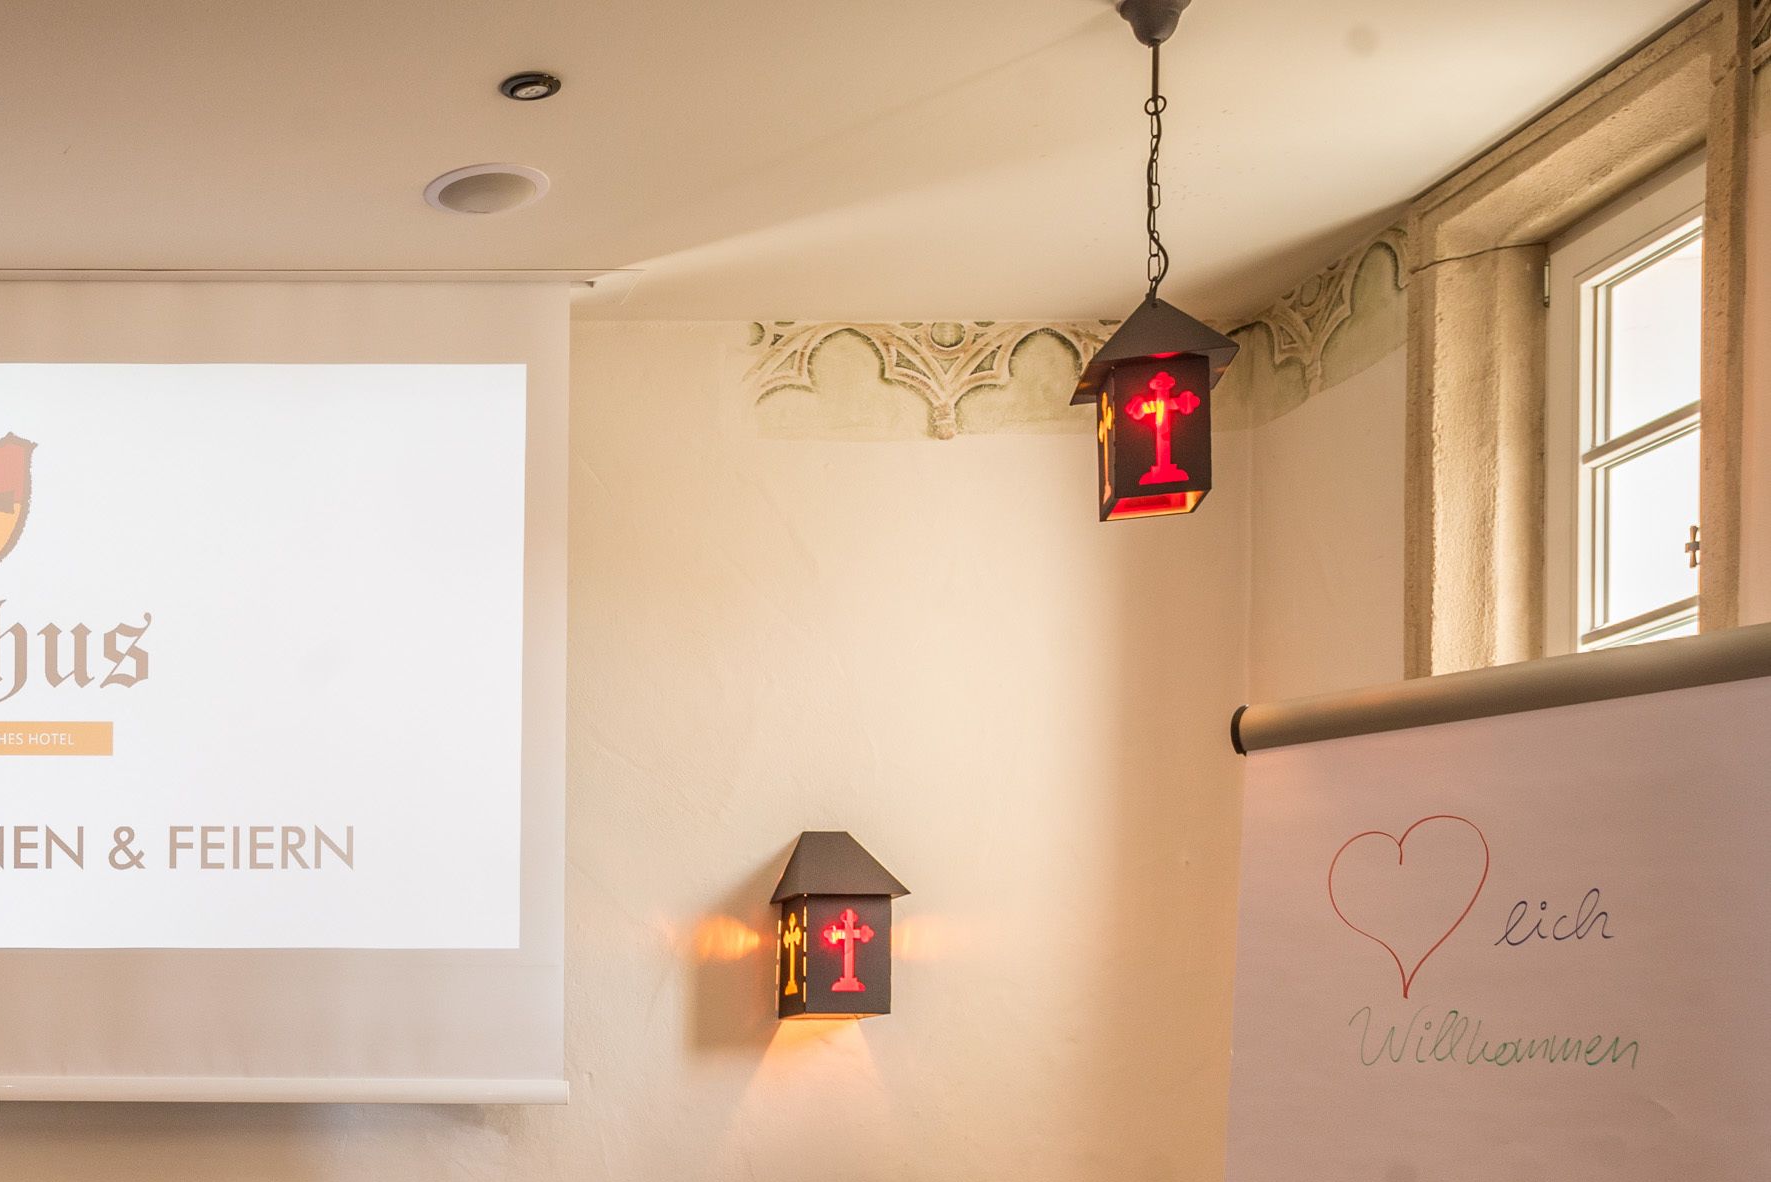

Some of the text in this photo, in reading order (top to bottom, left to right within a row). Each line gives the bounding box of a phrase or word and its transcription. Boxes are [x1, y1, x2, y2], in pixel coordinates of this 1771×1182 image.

[29, 732, 75, 746] HOTEL
[108, 826, 147, 872] &
[169, 826, 354, 871] FEIERN
